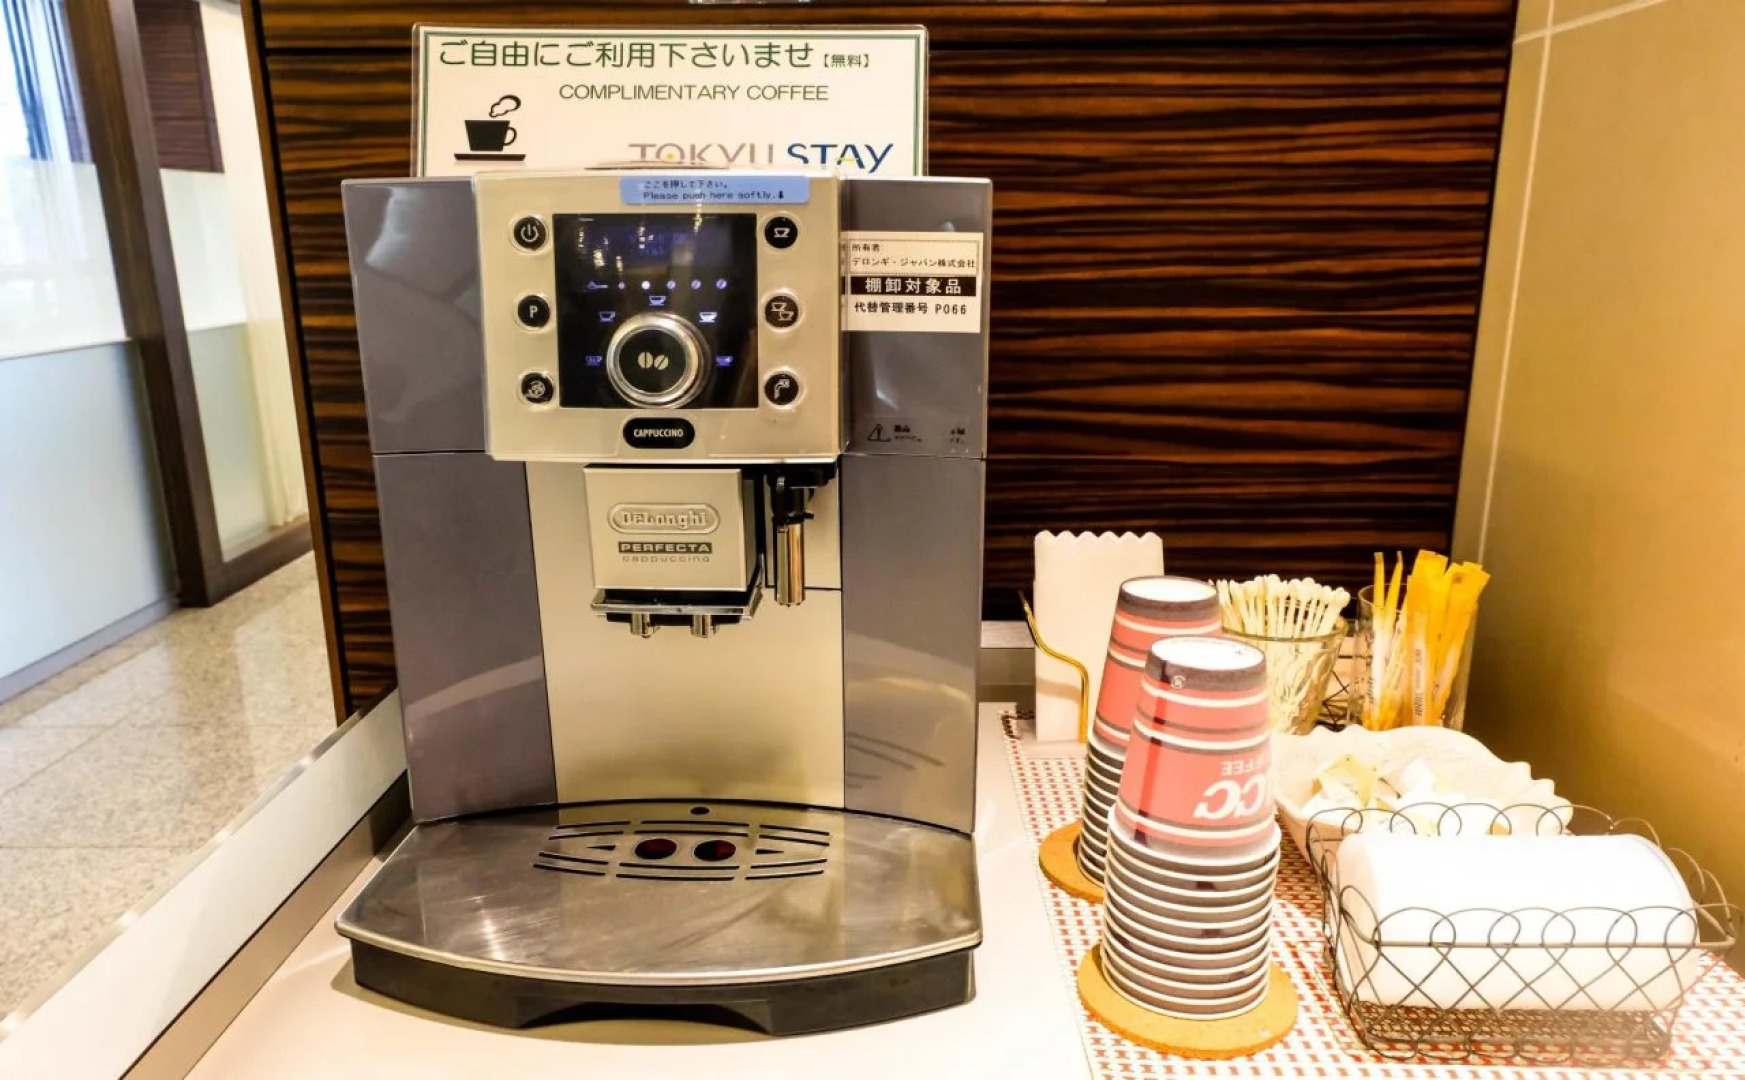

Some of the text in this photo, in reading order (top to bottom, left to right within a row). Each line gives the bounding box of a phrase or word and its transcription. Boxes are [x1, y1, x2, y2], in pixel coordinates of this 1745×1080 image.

[440, 40, 814, 69] ご自由にご利用下さいませ
[558, 84, 741, 101] COMPLIMENTARY
[747, 84, 829, 101] COFFEE
[628, 142, 894, 174] TOKYU STAY
[643, 191, 775, 201] Please push here softly.
[865, 277, 961, 295] 棚卸対象品
[529, 305, 538, 319] P
[854, 301, 967, 315] 代替管理番号 P066
[633, 428, 684, 438] CAPPUCCINO
[620, 543, 710, 552] PERFECTA
[622, 555, 710, 563] cappuccino
